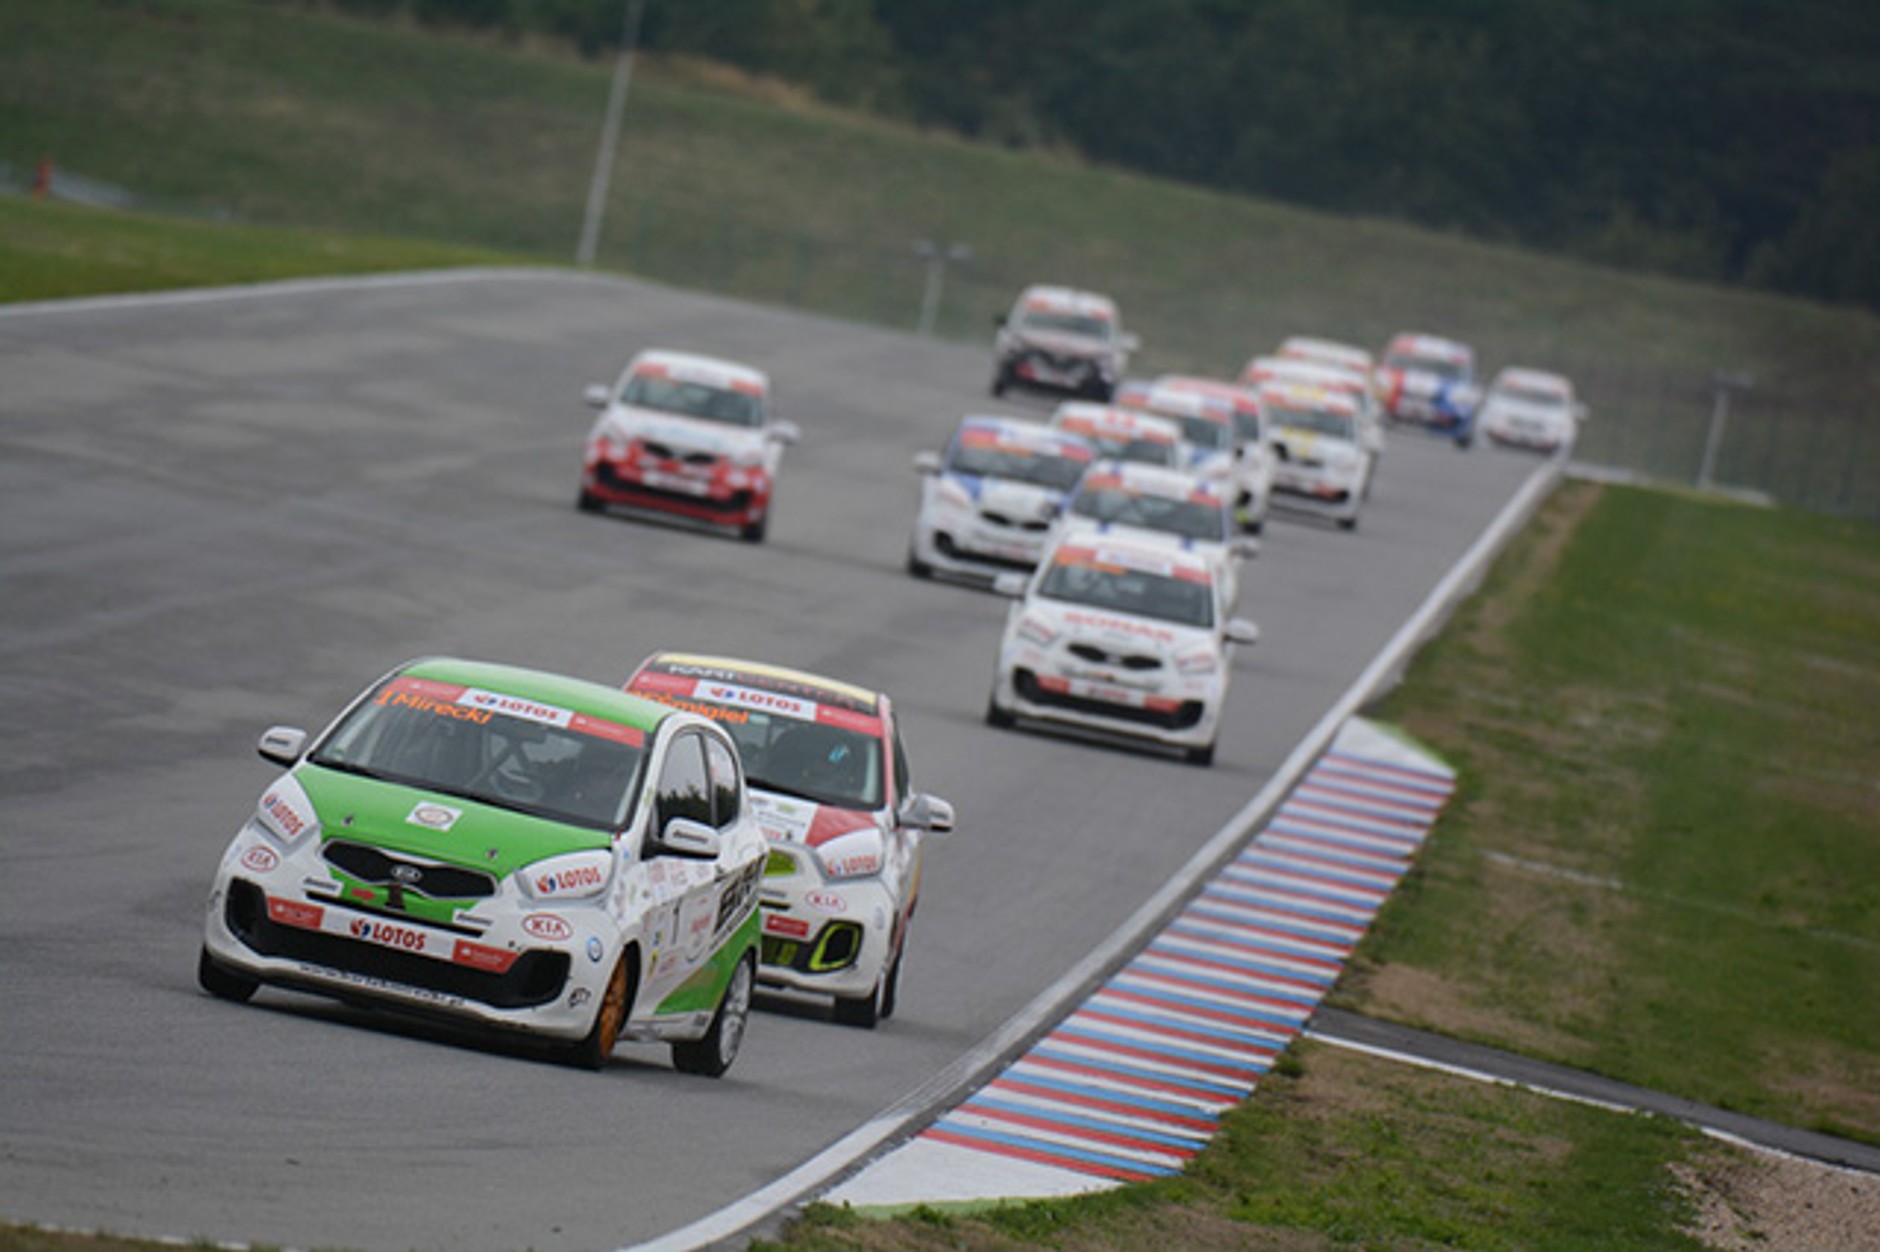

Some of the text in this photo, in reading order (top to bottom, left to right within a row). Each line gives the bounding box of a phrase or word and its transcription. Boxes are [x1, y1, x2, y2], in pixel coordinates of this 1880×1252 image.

[499, 699, 560, 722] LOTOS
[739, 691, 802, 713] LOTOS
[269, 801, 304, 836] LOTOS
[556, 866, 602, 890] LOTOS
[372, 922, 427, 950] LOTOS
[530, 919, 568, 938] KIA
